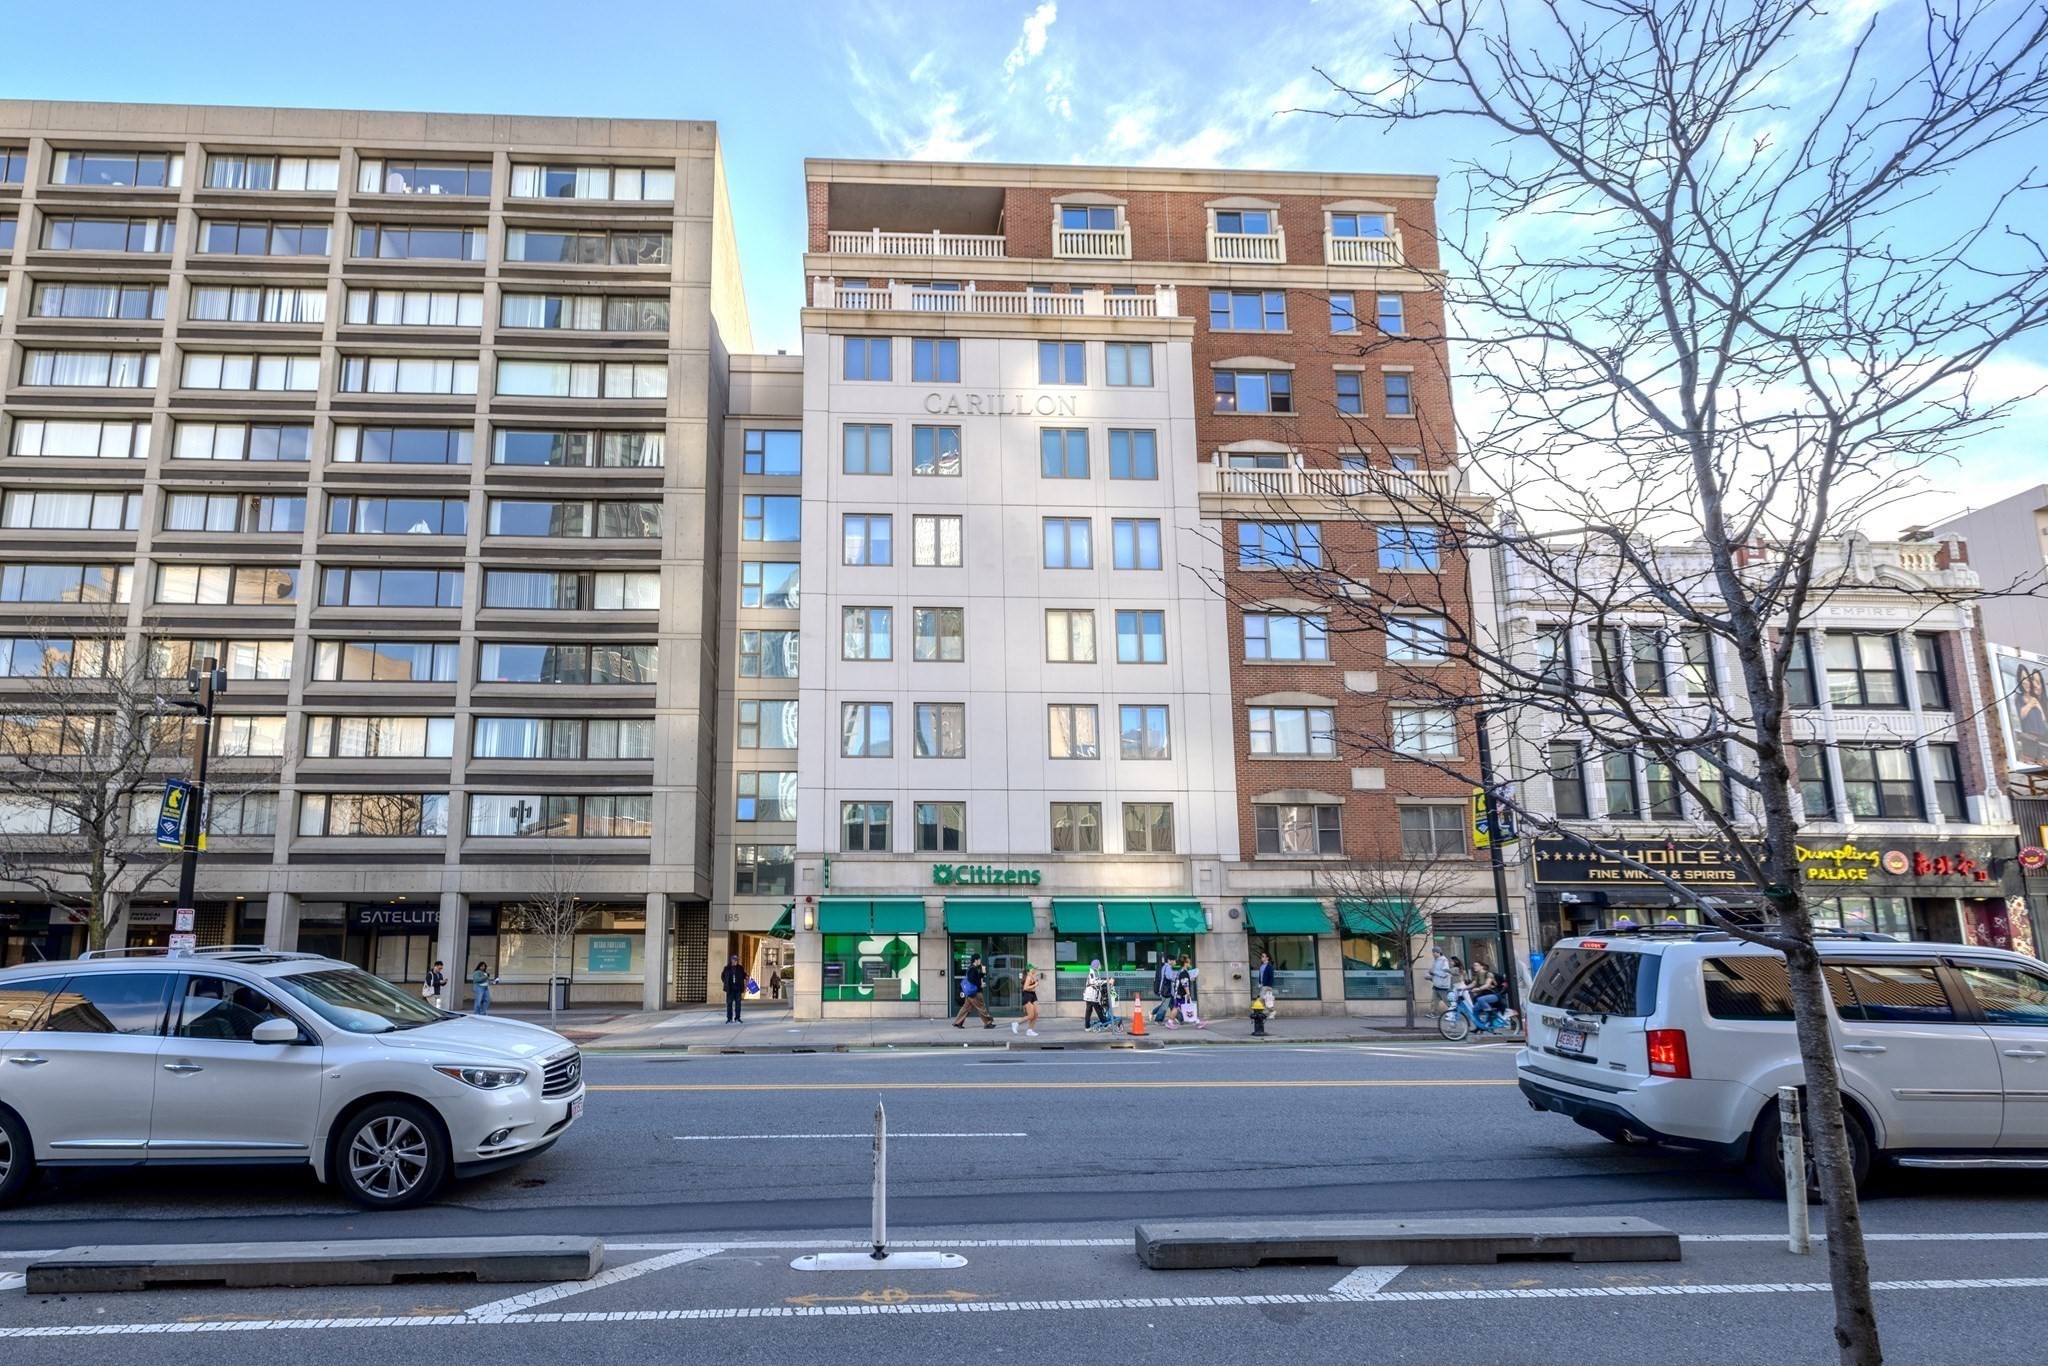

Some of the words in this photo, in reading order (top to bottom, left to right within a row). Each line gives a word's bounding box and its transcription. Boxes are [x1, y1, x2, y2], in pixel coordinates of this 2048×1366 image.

[923, 393, 1076, 416] CARILLON
[1831, 607, 1896, 616] EMPIRE
[1794, 844, 1880, 867] Dumpling
[955, 865, 1041, 884] Citizens
[1589, 869, 1619, 879] FINE
[1623, 869, 1666, 880] WINS
[1684, 870, 1735, 880] SPIRITS
[1807, 868, 1868, 880] PALACE
[724, 913, 739, 922] 185
